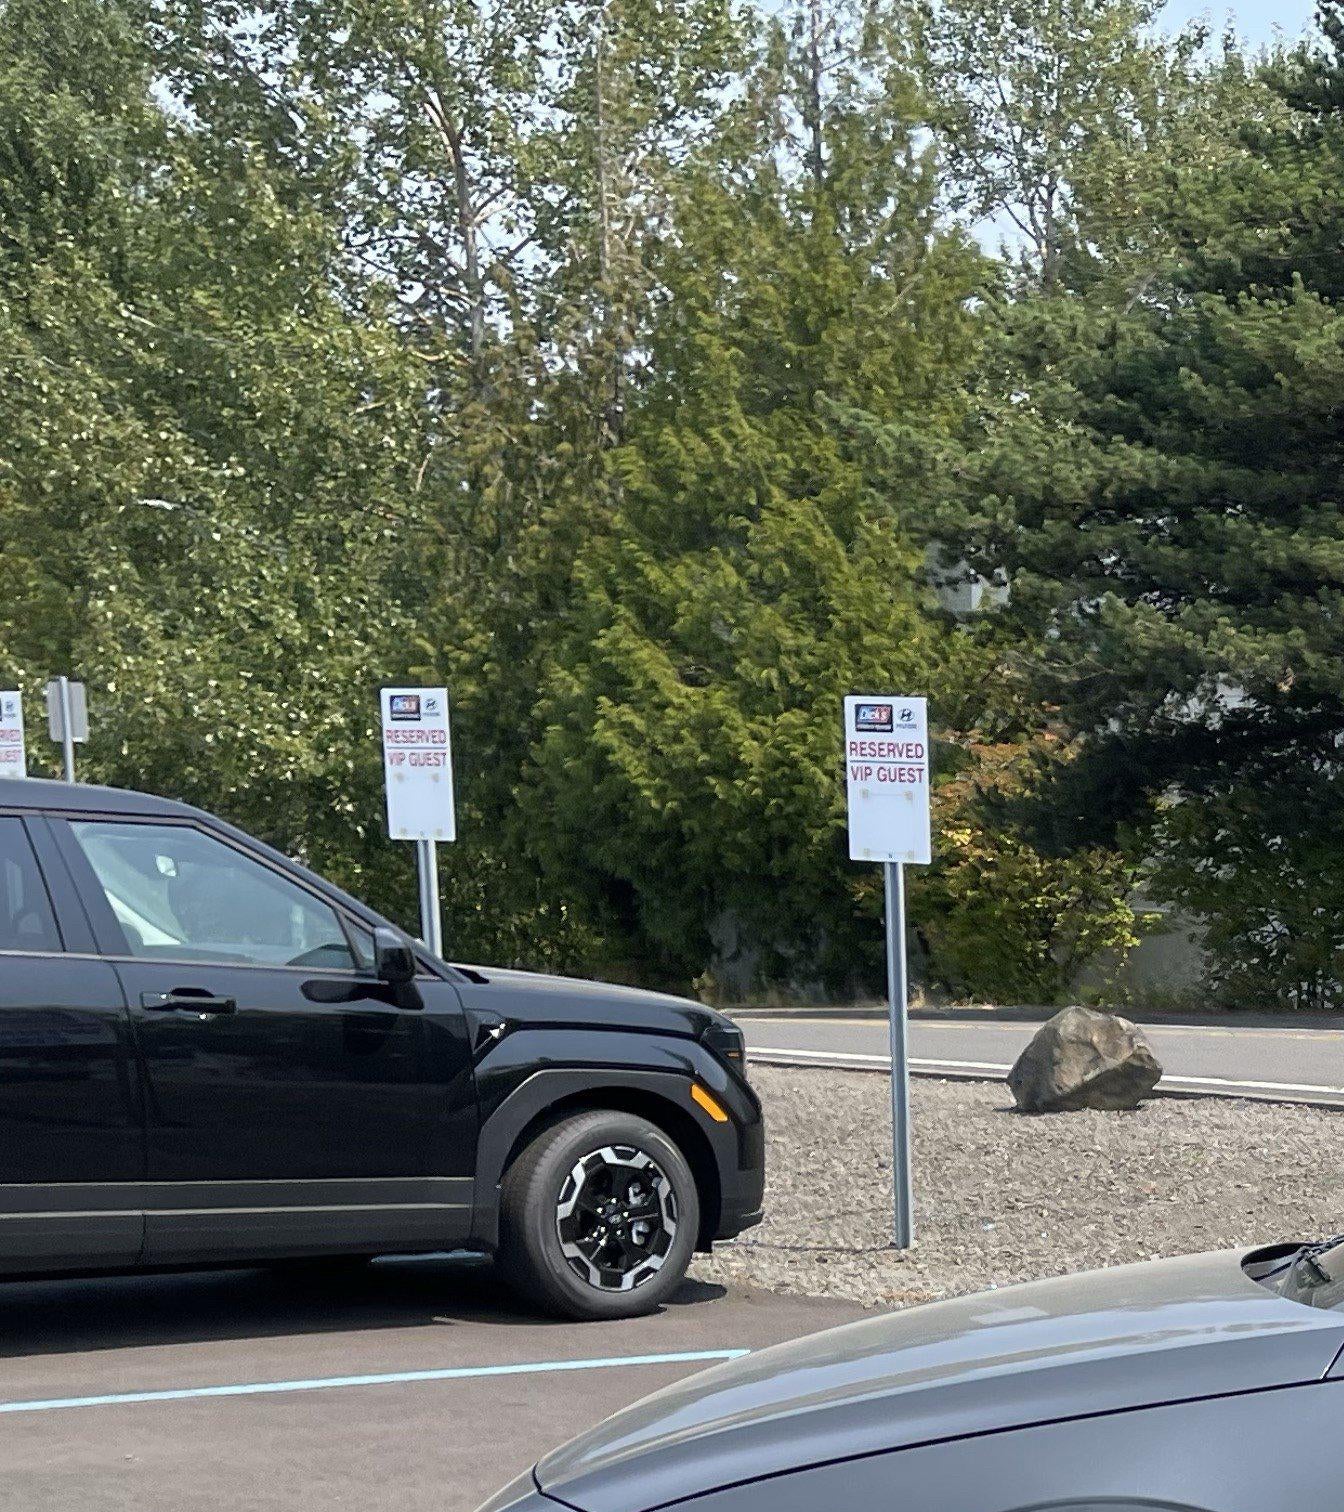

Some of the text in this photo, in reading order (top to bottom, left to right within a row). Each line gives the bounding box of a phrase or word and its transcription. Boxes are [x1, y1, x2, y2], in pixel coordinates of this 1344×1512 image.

[386, 729, 447, 744] RESERVED
[849, 741, 925, 759] RESERVED
[388, 752, 447, 767] VIP GUEST
[850, 766, 925, 784] VIP GUEST
